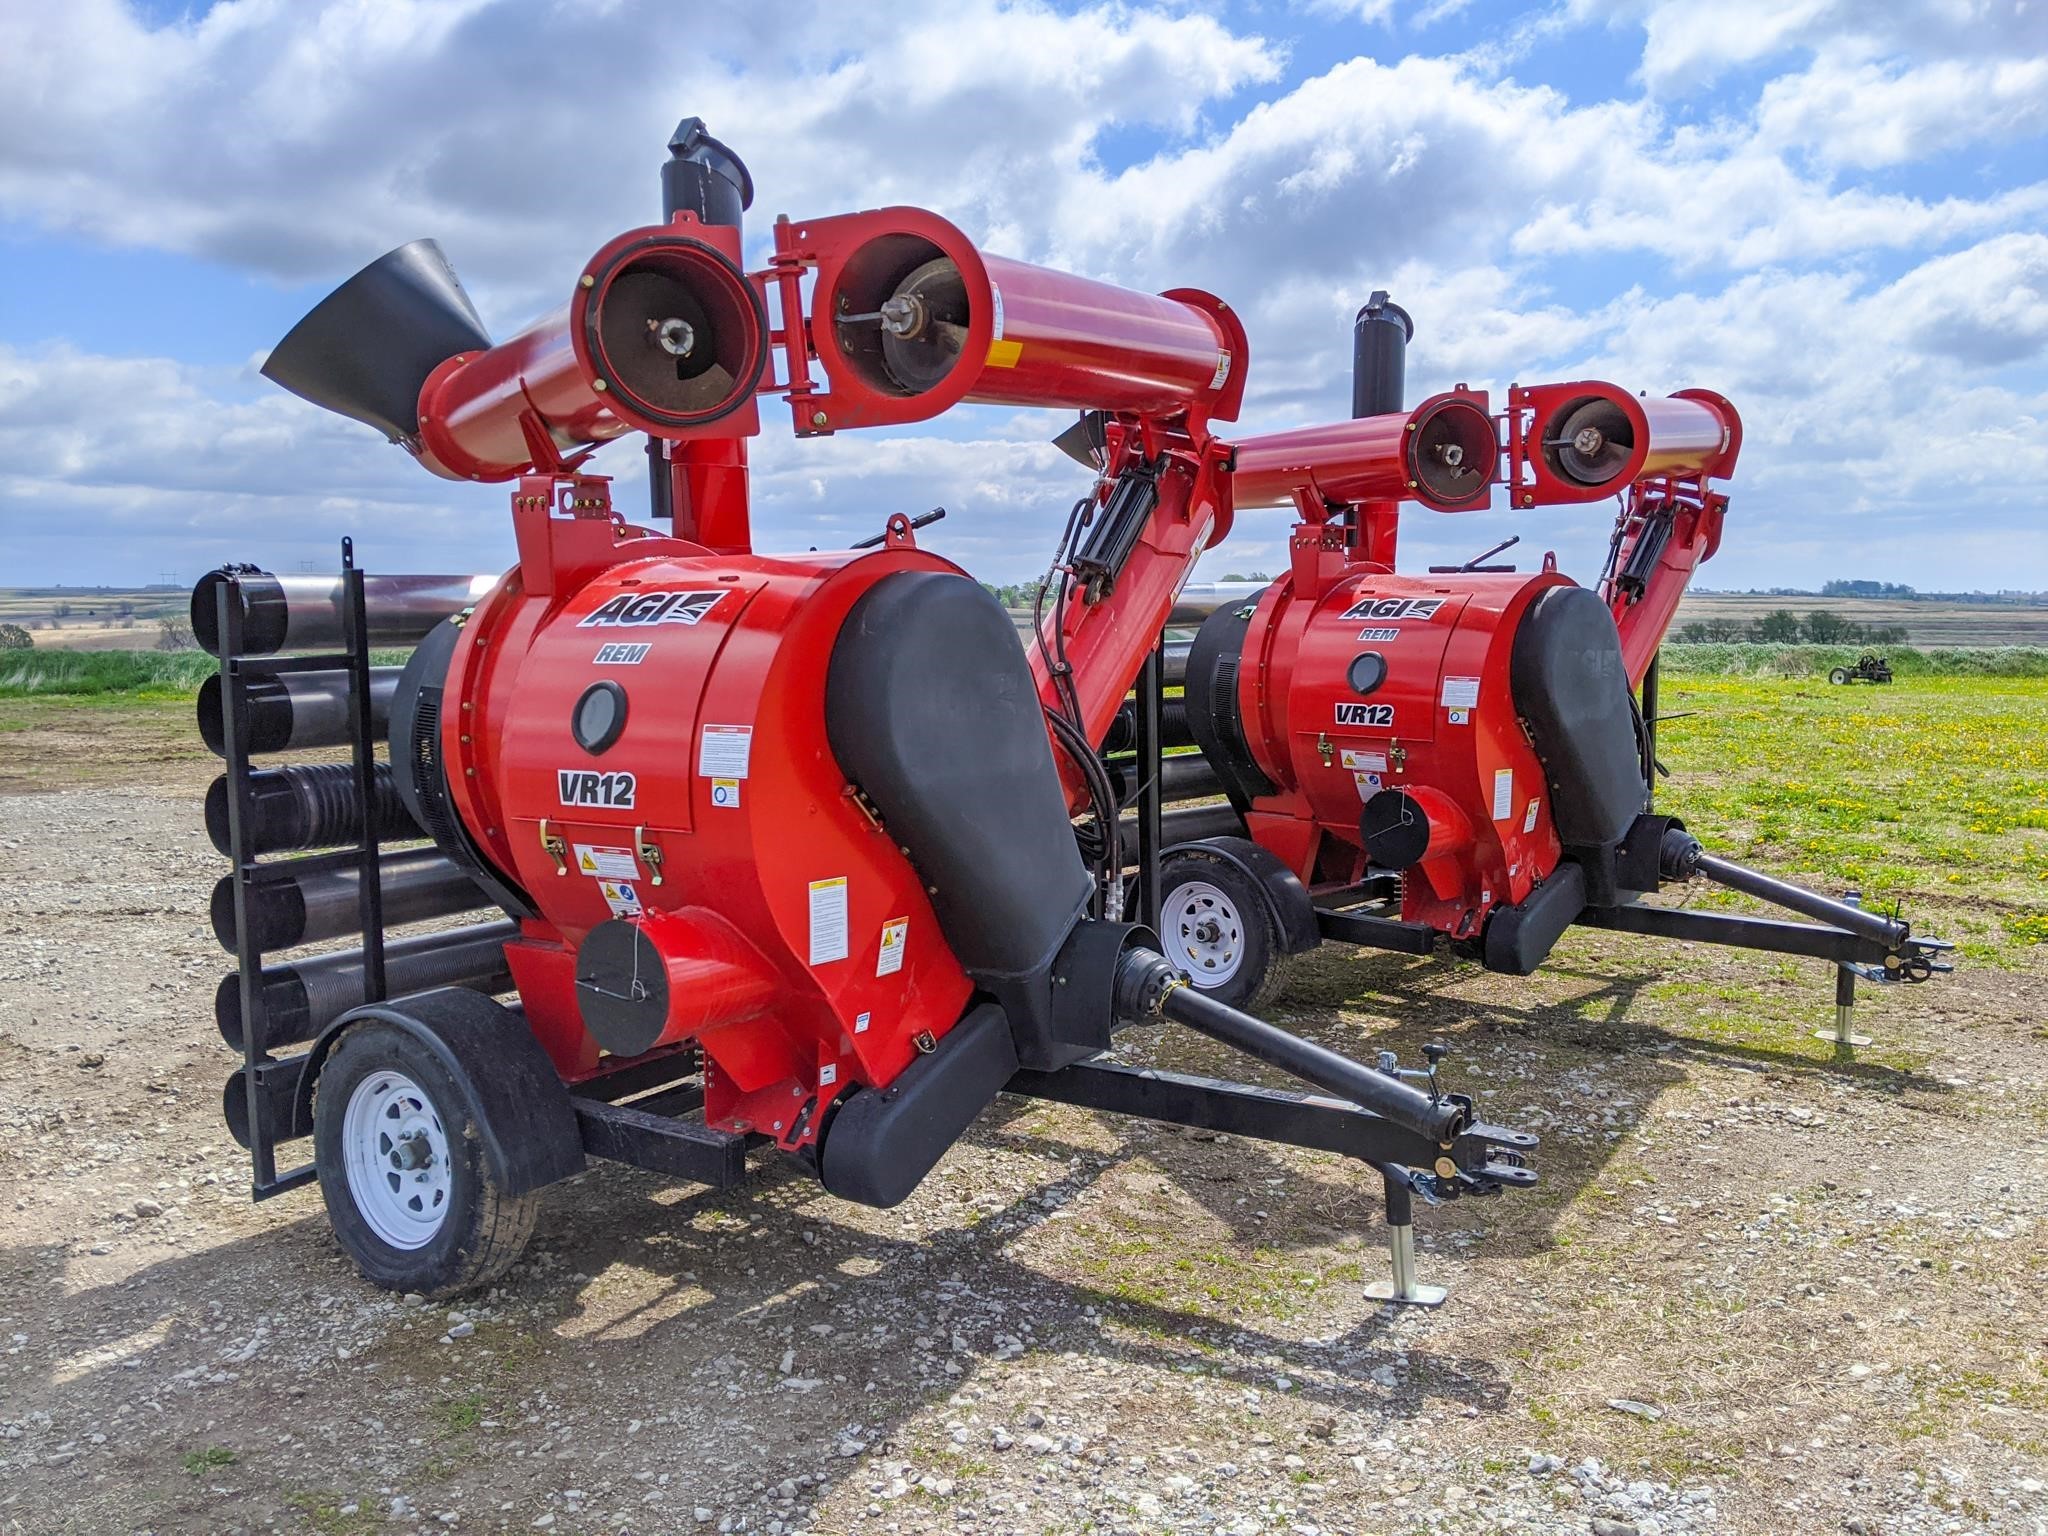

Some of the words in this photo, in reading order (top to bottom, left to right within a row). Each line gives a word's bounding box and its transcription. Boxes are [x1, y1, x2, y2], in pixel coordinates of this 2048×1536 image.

[583, 593, 676, 624] AGI
[1346, 600, 1408, 617] AGI
[1361, 629, 1397, 640] REM
[596, 645, 646, 662] REM
[1336, 705, 1393, 724] VR12
[560, 772, 634, 806] VR12
